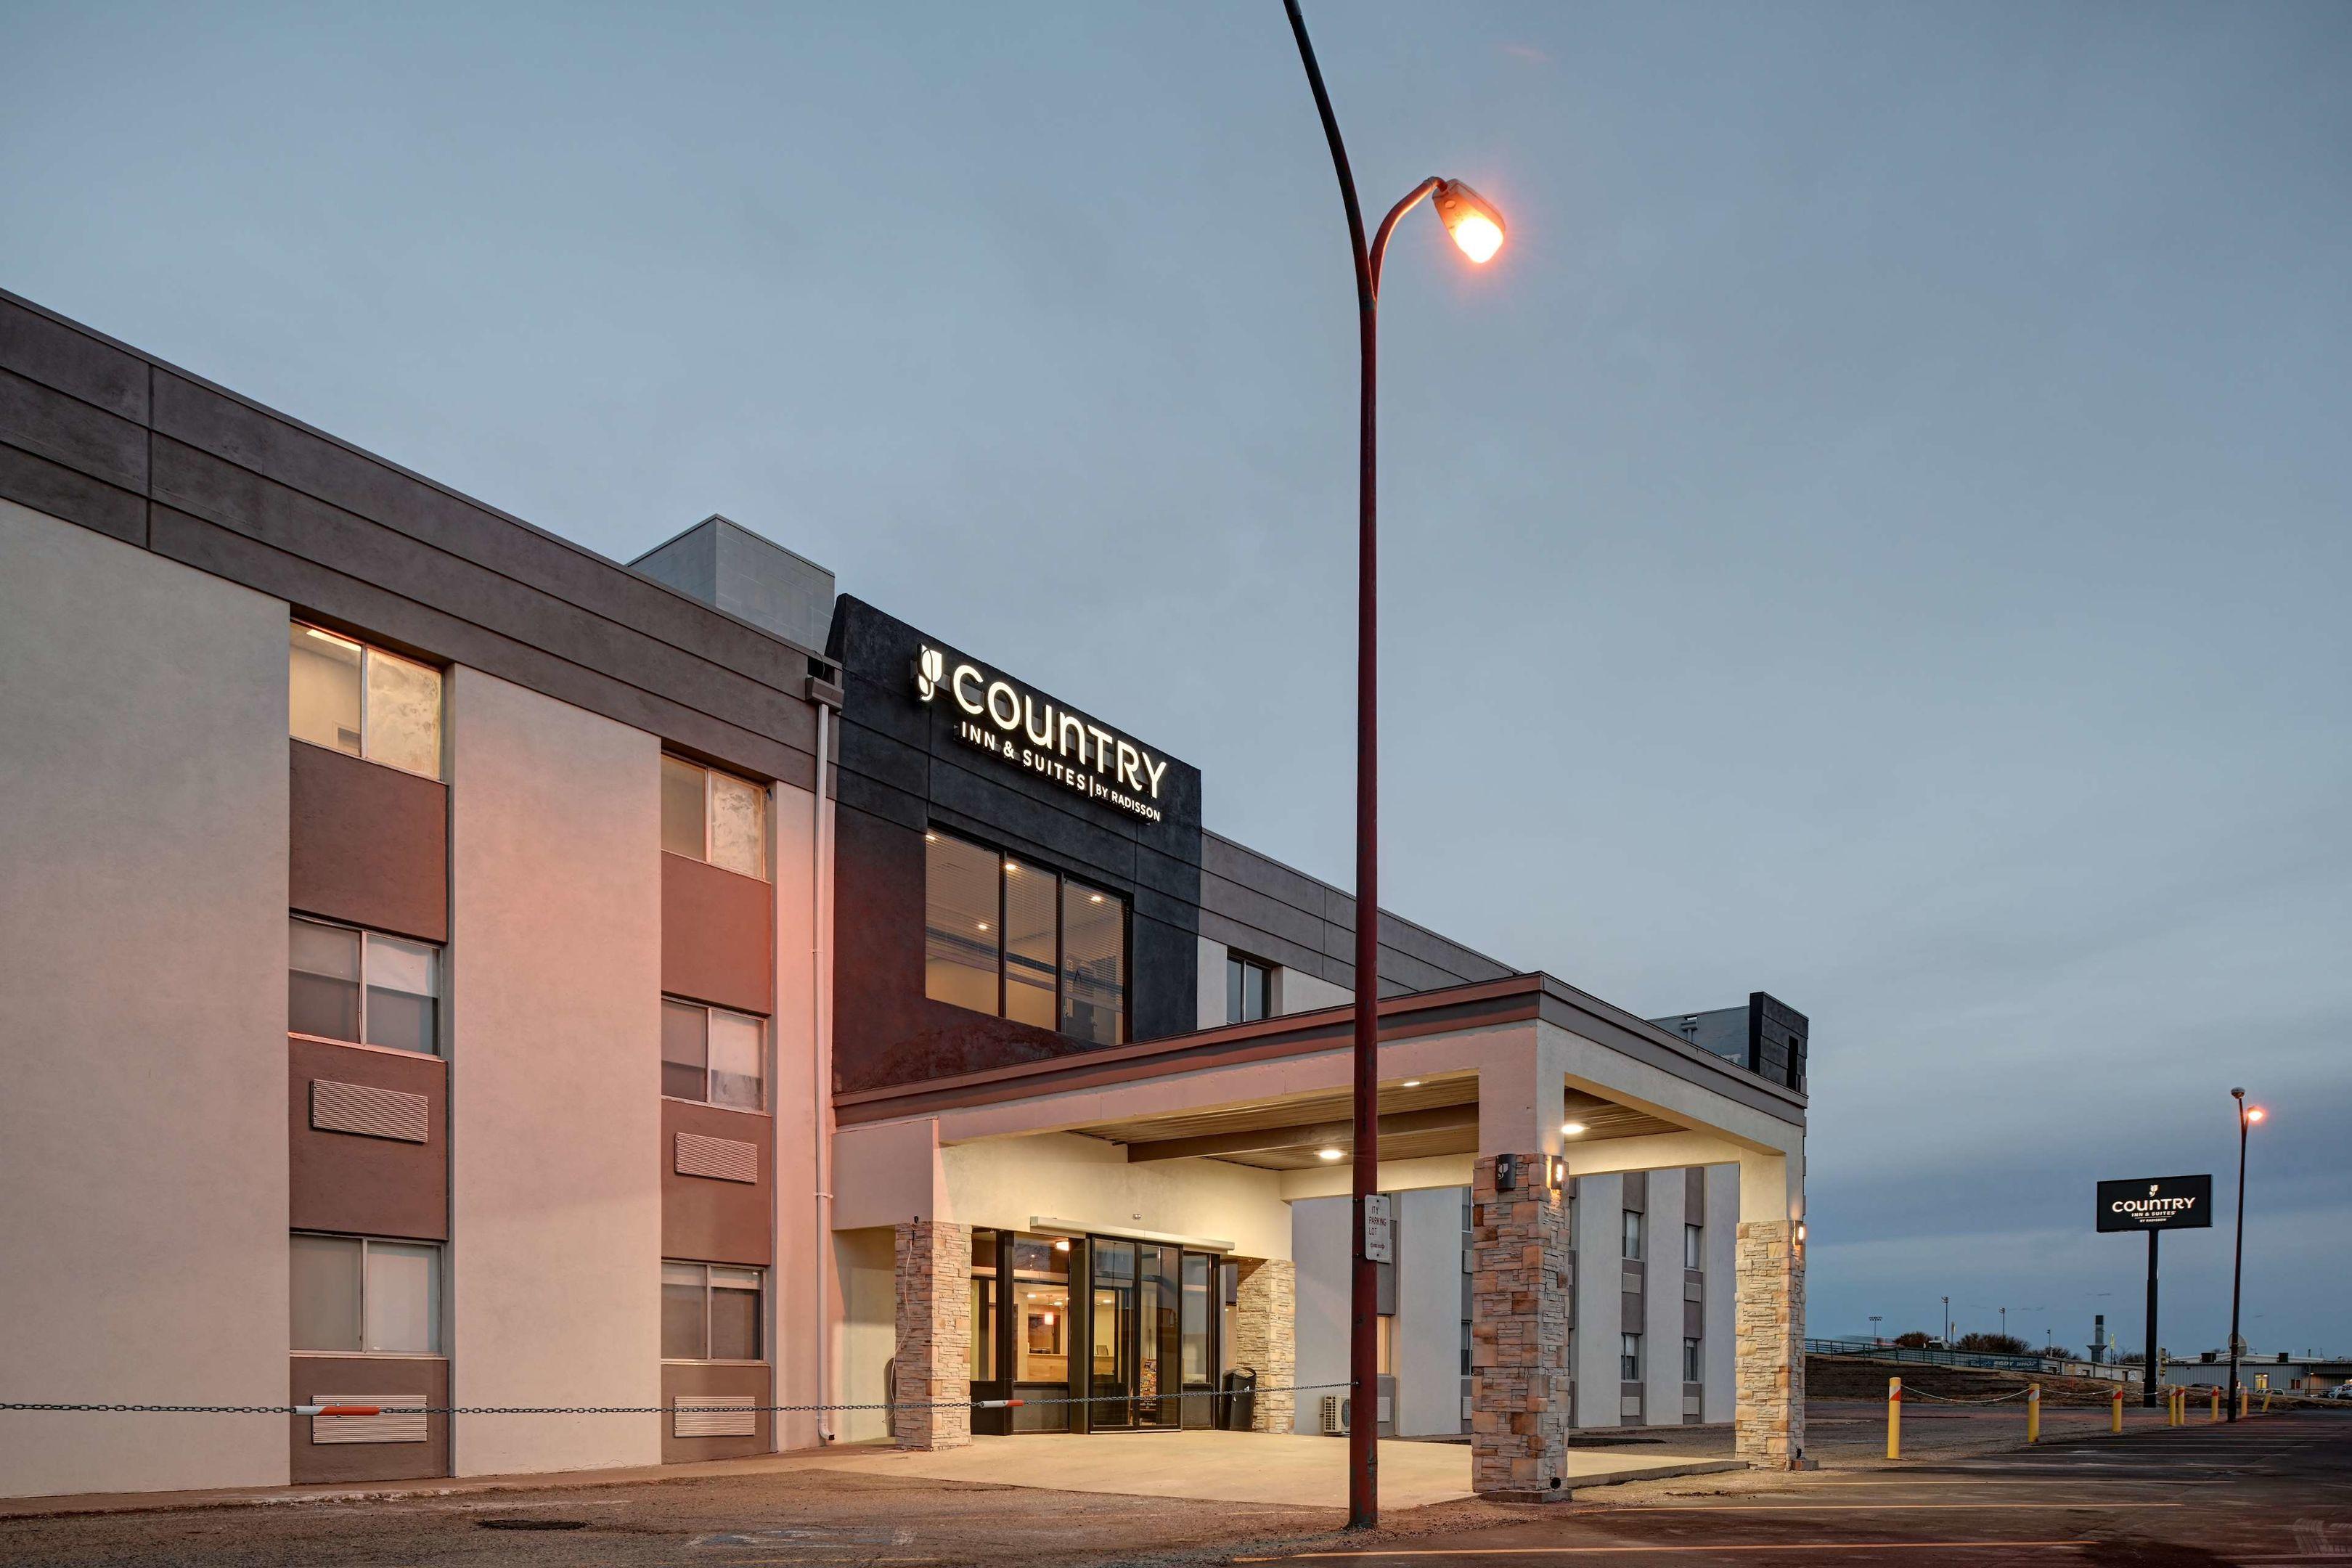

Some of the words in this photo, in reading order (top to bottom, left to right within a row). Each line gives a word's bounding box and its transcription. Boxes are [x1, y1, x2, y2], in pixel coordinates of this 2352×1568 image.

[961, 721, 995, 751] INN
[1003, 740, 1015, 759] &
[1022, 749, 1085, 791] SUITES
[1096, 783, 1108, 798] BY
[1111, 791, 1160, 822] RADISSON
[1368, 1216, 1387, 1227] PARKING
[1368, 1227, 1377, 1236] LOT
